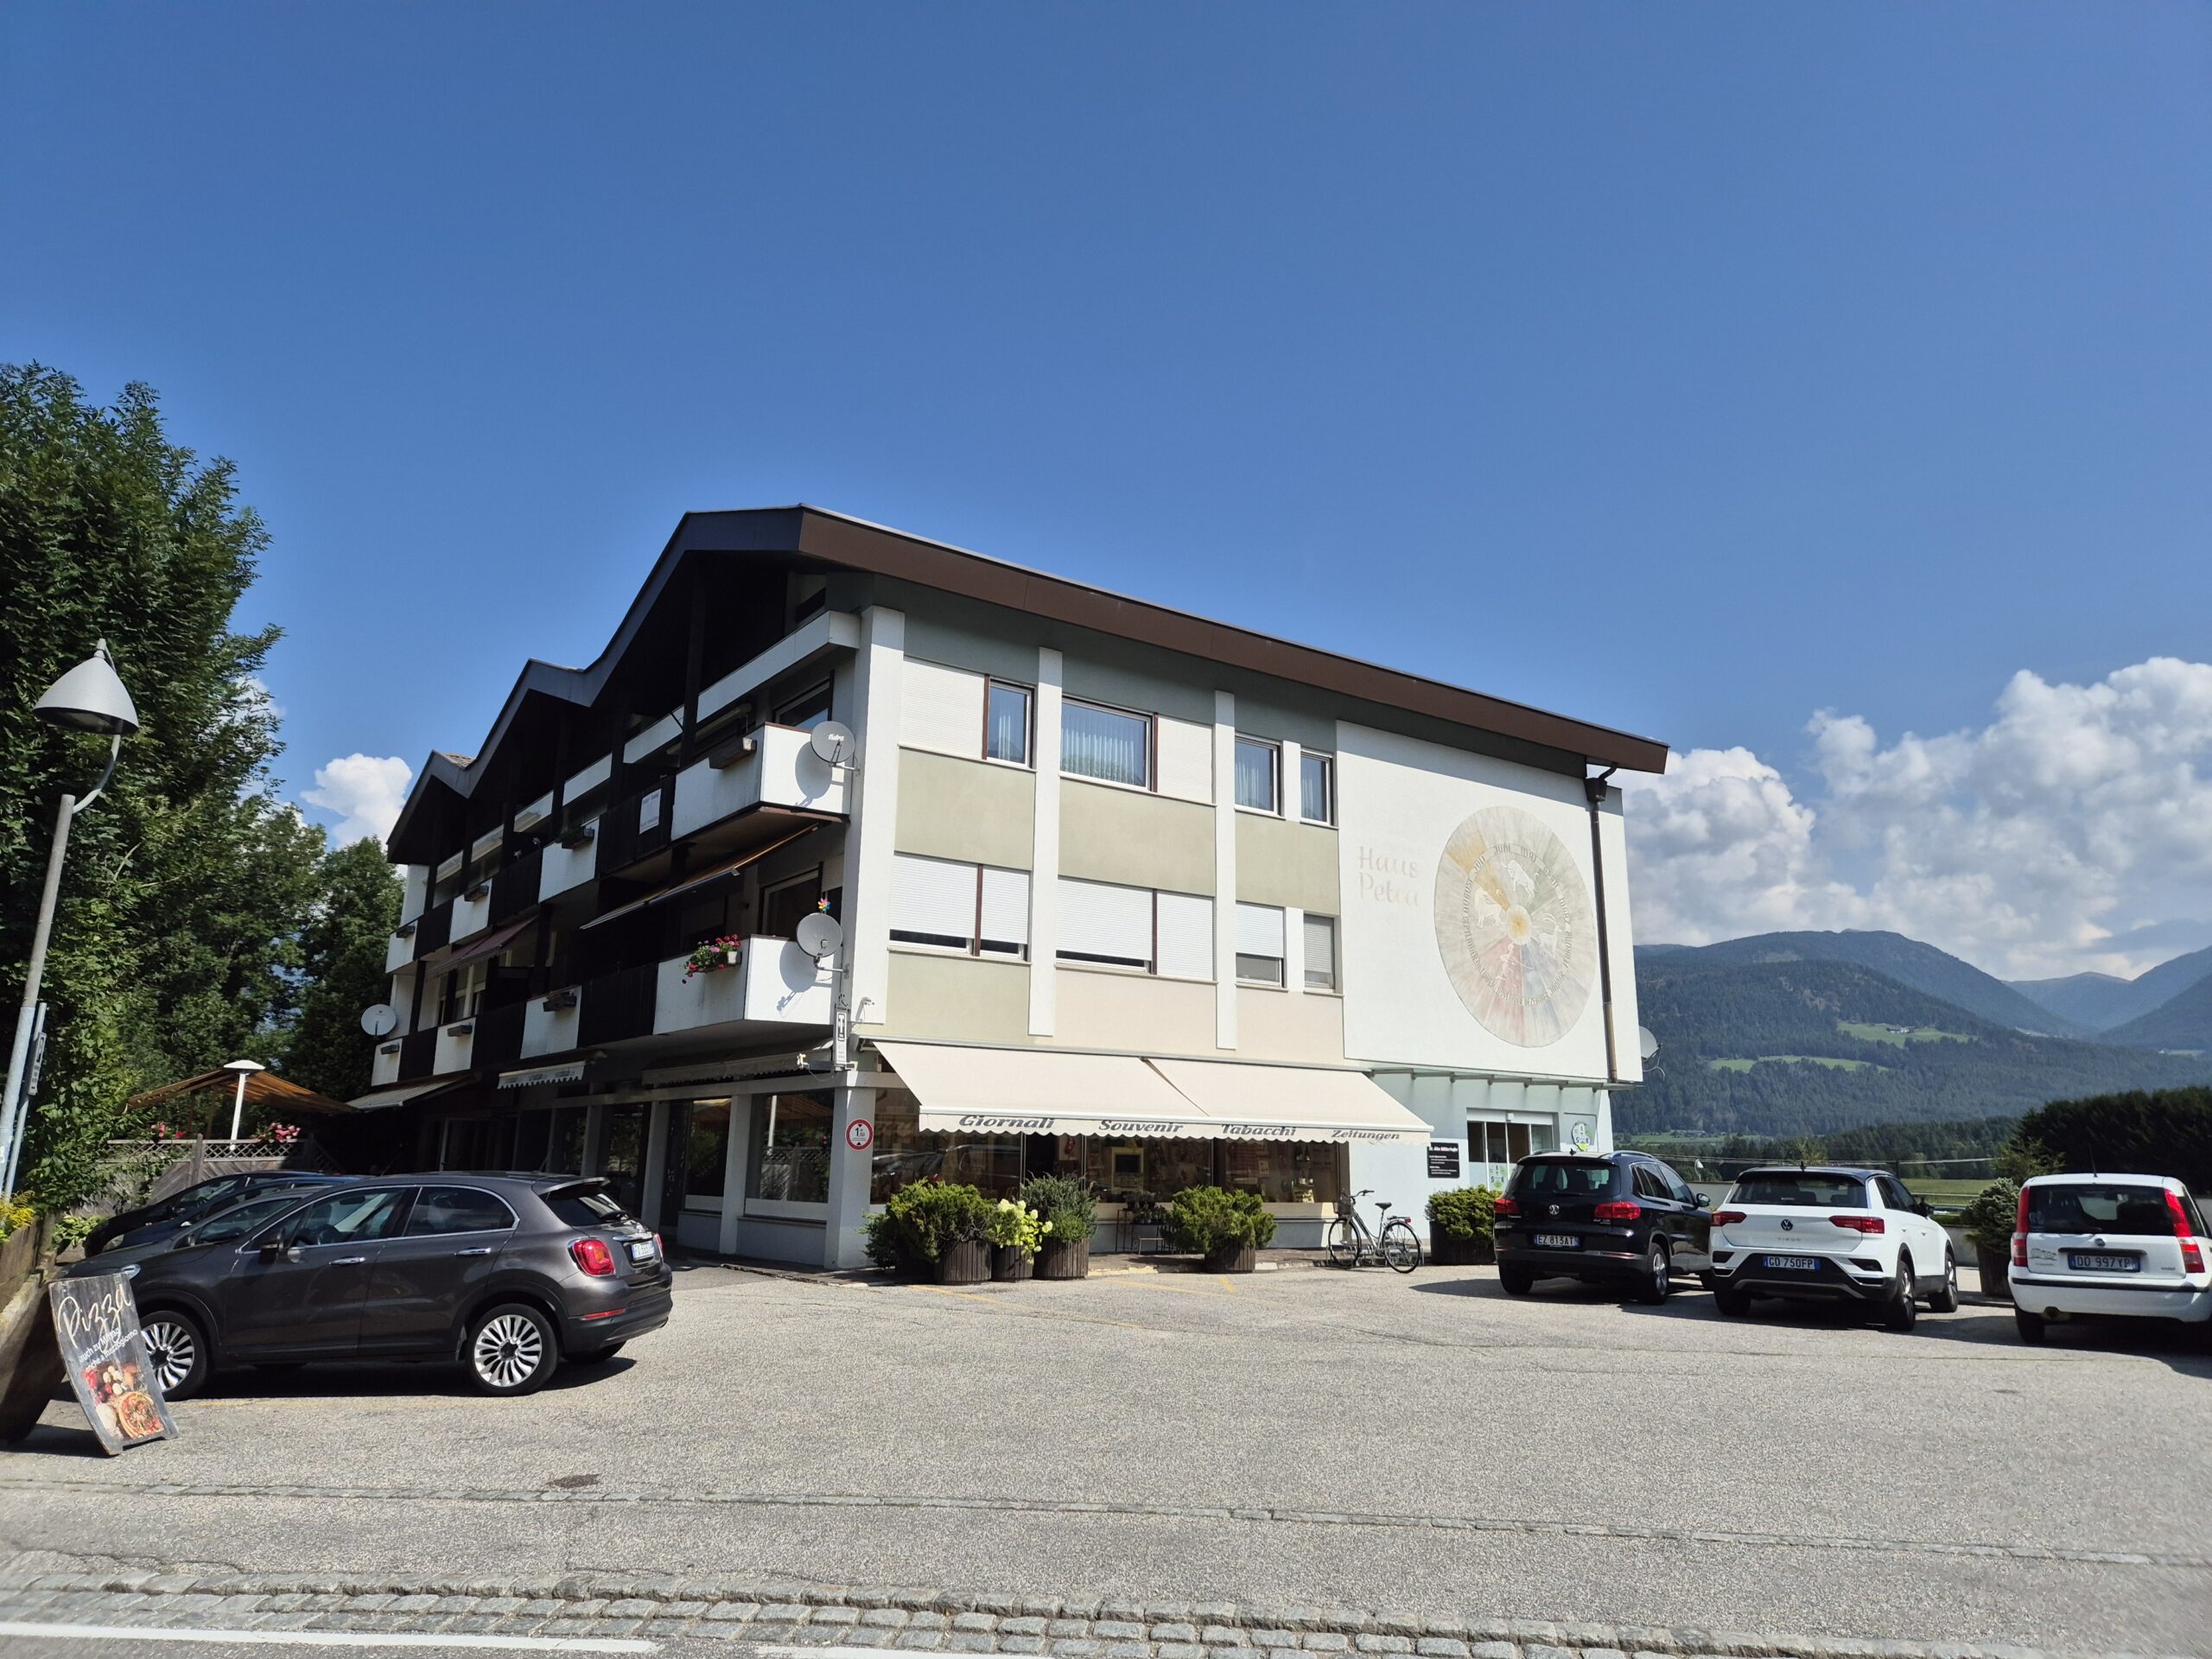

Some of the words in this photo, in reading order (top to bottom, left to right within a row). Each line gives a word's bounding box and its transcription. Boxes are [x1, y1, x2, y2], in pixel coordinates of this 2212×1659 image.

[1358, 846, 1418, 878] Haus
[1359, 872, 1418, 906] Petra
[958, 1115, 1054, 1128] Giornali
[1099, 1119, 1184, 1133] Souvenir
[1221, 1124, 1297, 1136] Tabacchi
[1331, 1129, 1400, 1141] Zeitungen
[1538, 1235, 1548, 1244] EZ
[1549, 1235, 1574, 1245] 813AT
[1783, 1258, 1813, 1268] 750FP
[58, 1283, 132, 1354] Pizza
